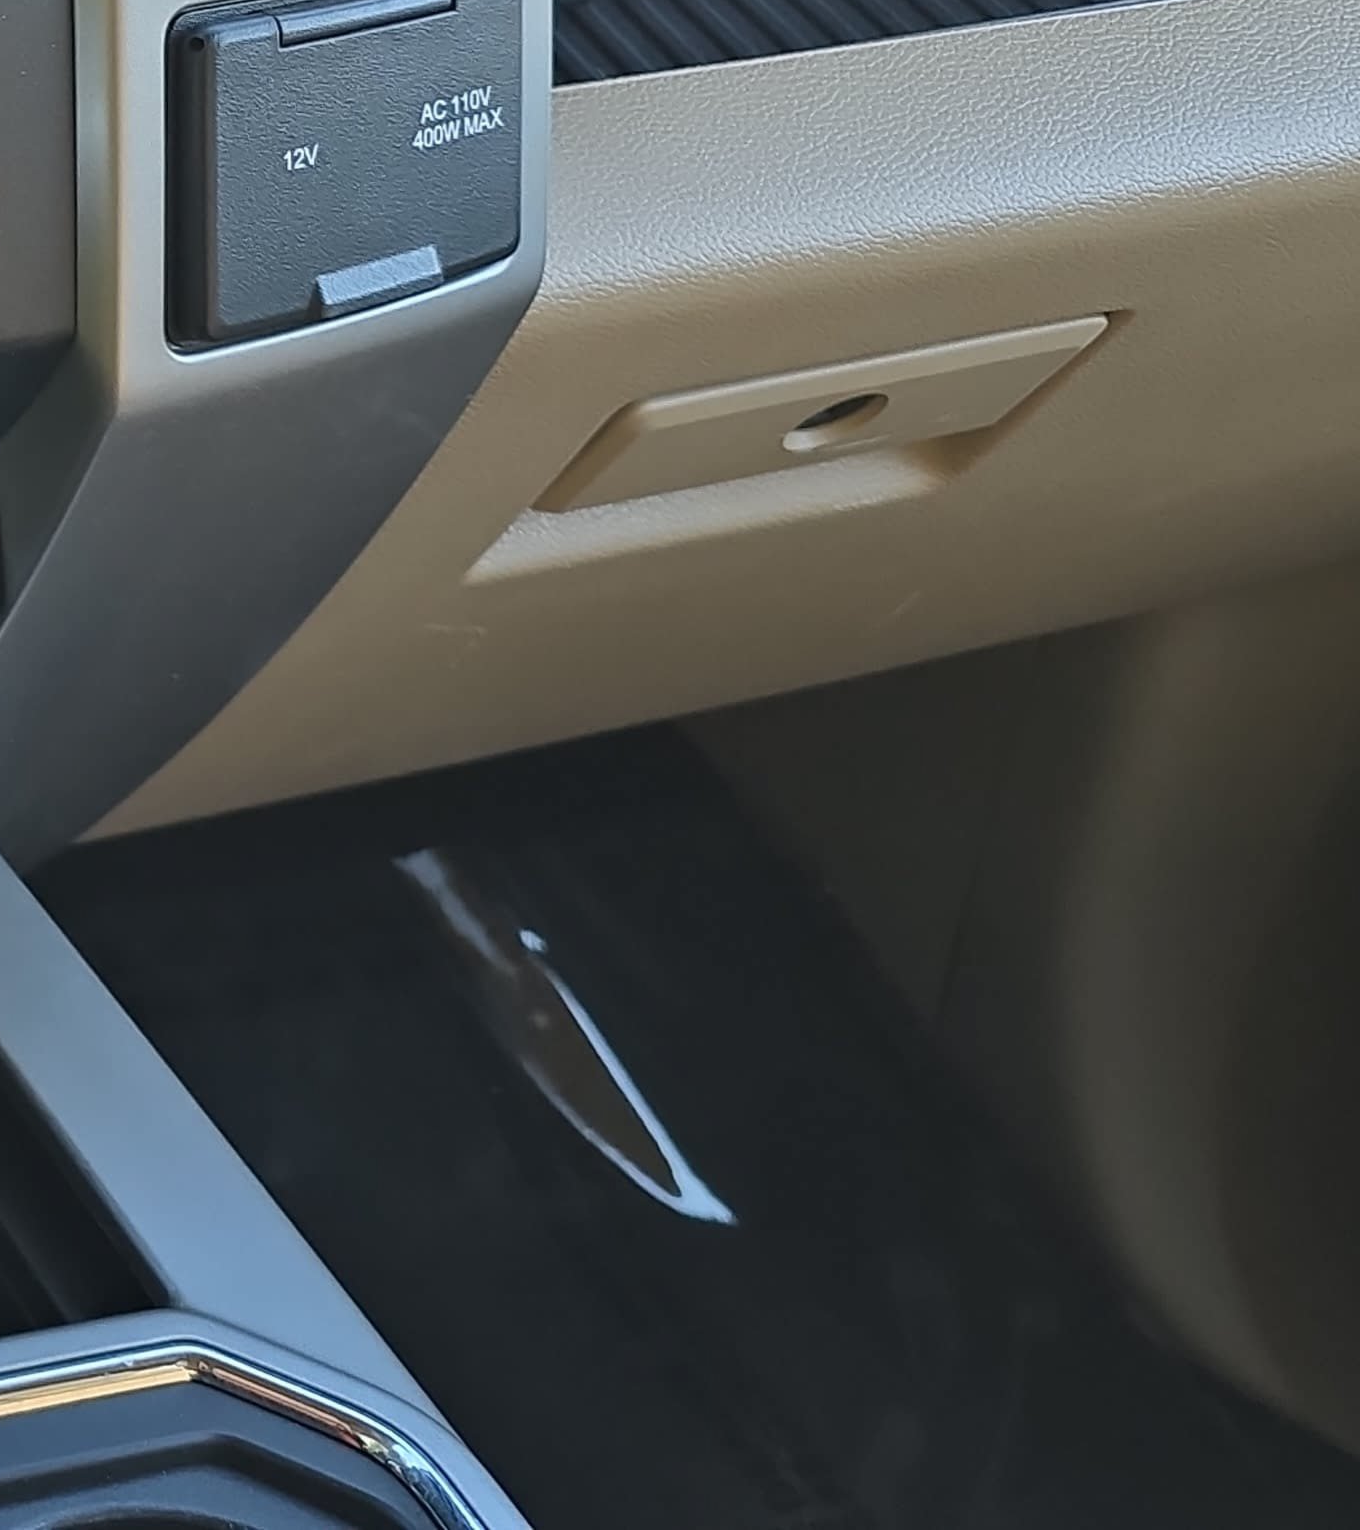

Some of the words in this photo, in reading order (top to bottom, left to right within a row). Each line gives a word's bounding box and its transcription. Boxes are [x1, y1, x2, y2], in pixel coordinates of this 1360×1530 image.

[419, 99, 448, 125] AC
[450, 85, 493, 116] 110V
[411, 118, 461, 151] 400W
[463, 106, 505, 138] MAX
[282, 143, 320, 172] 12V
